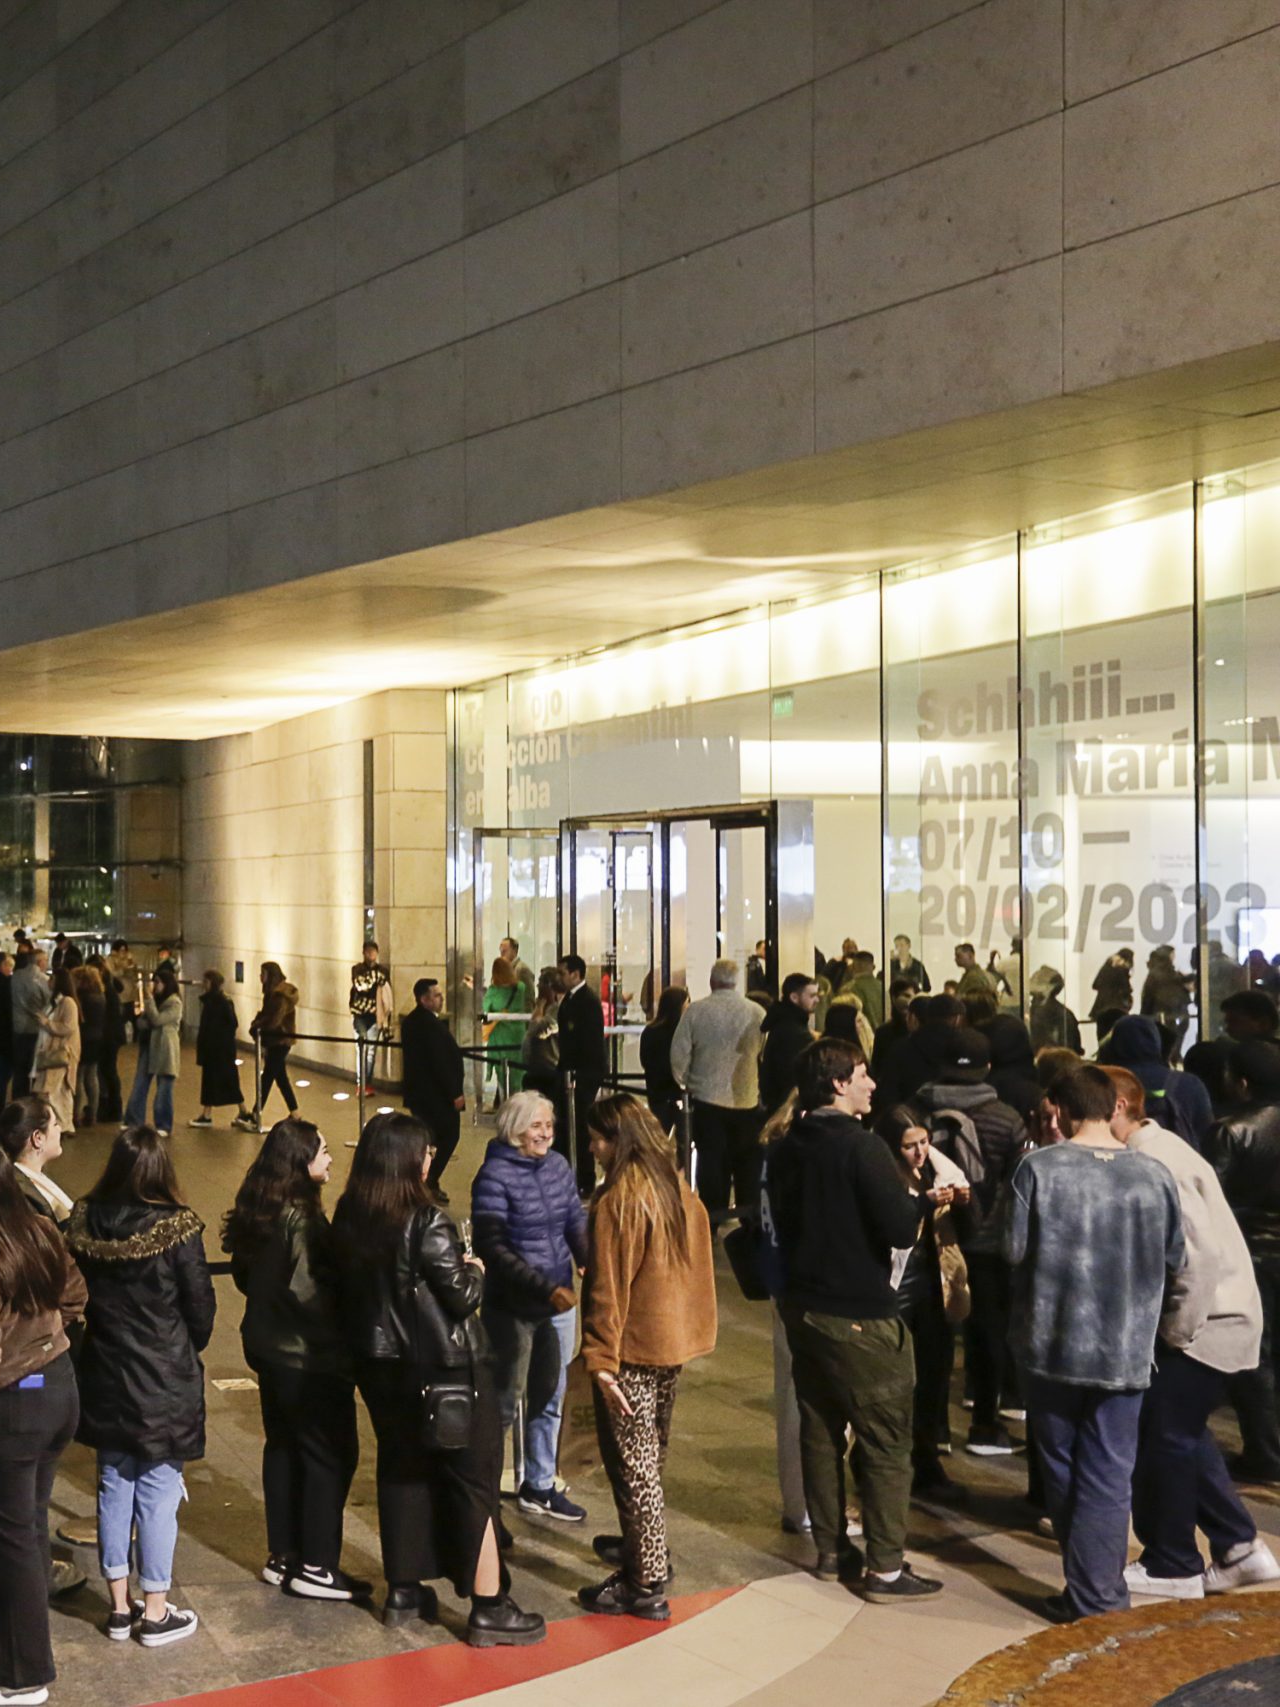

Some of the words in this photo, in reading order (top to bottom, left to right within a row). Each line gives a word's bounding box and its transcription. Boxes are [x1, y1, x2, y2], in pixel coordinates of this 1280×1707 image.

[916, 658, 1176, 741] Schhhiii...
[465, 732, 560, 775] Cocción
[916, 754, 1039, 806] Anna
[1056, 727, 1229, 797] María
[508, 775, 551, 813] alba
[917, 811, 1065, 882] 07/10
[917, 881, 1268, 954] 20/02/2023
